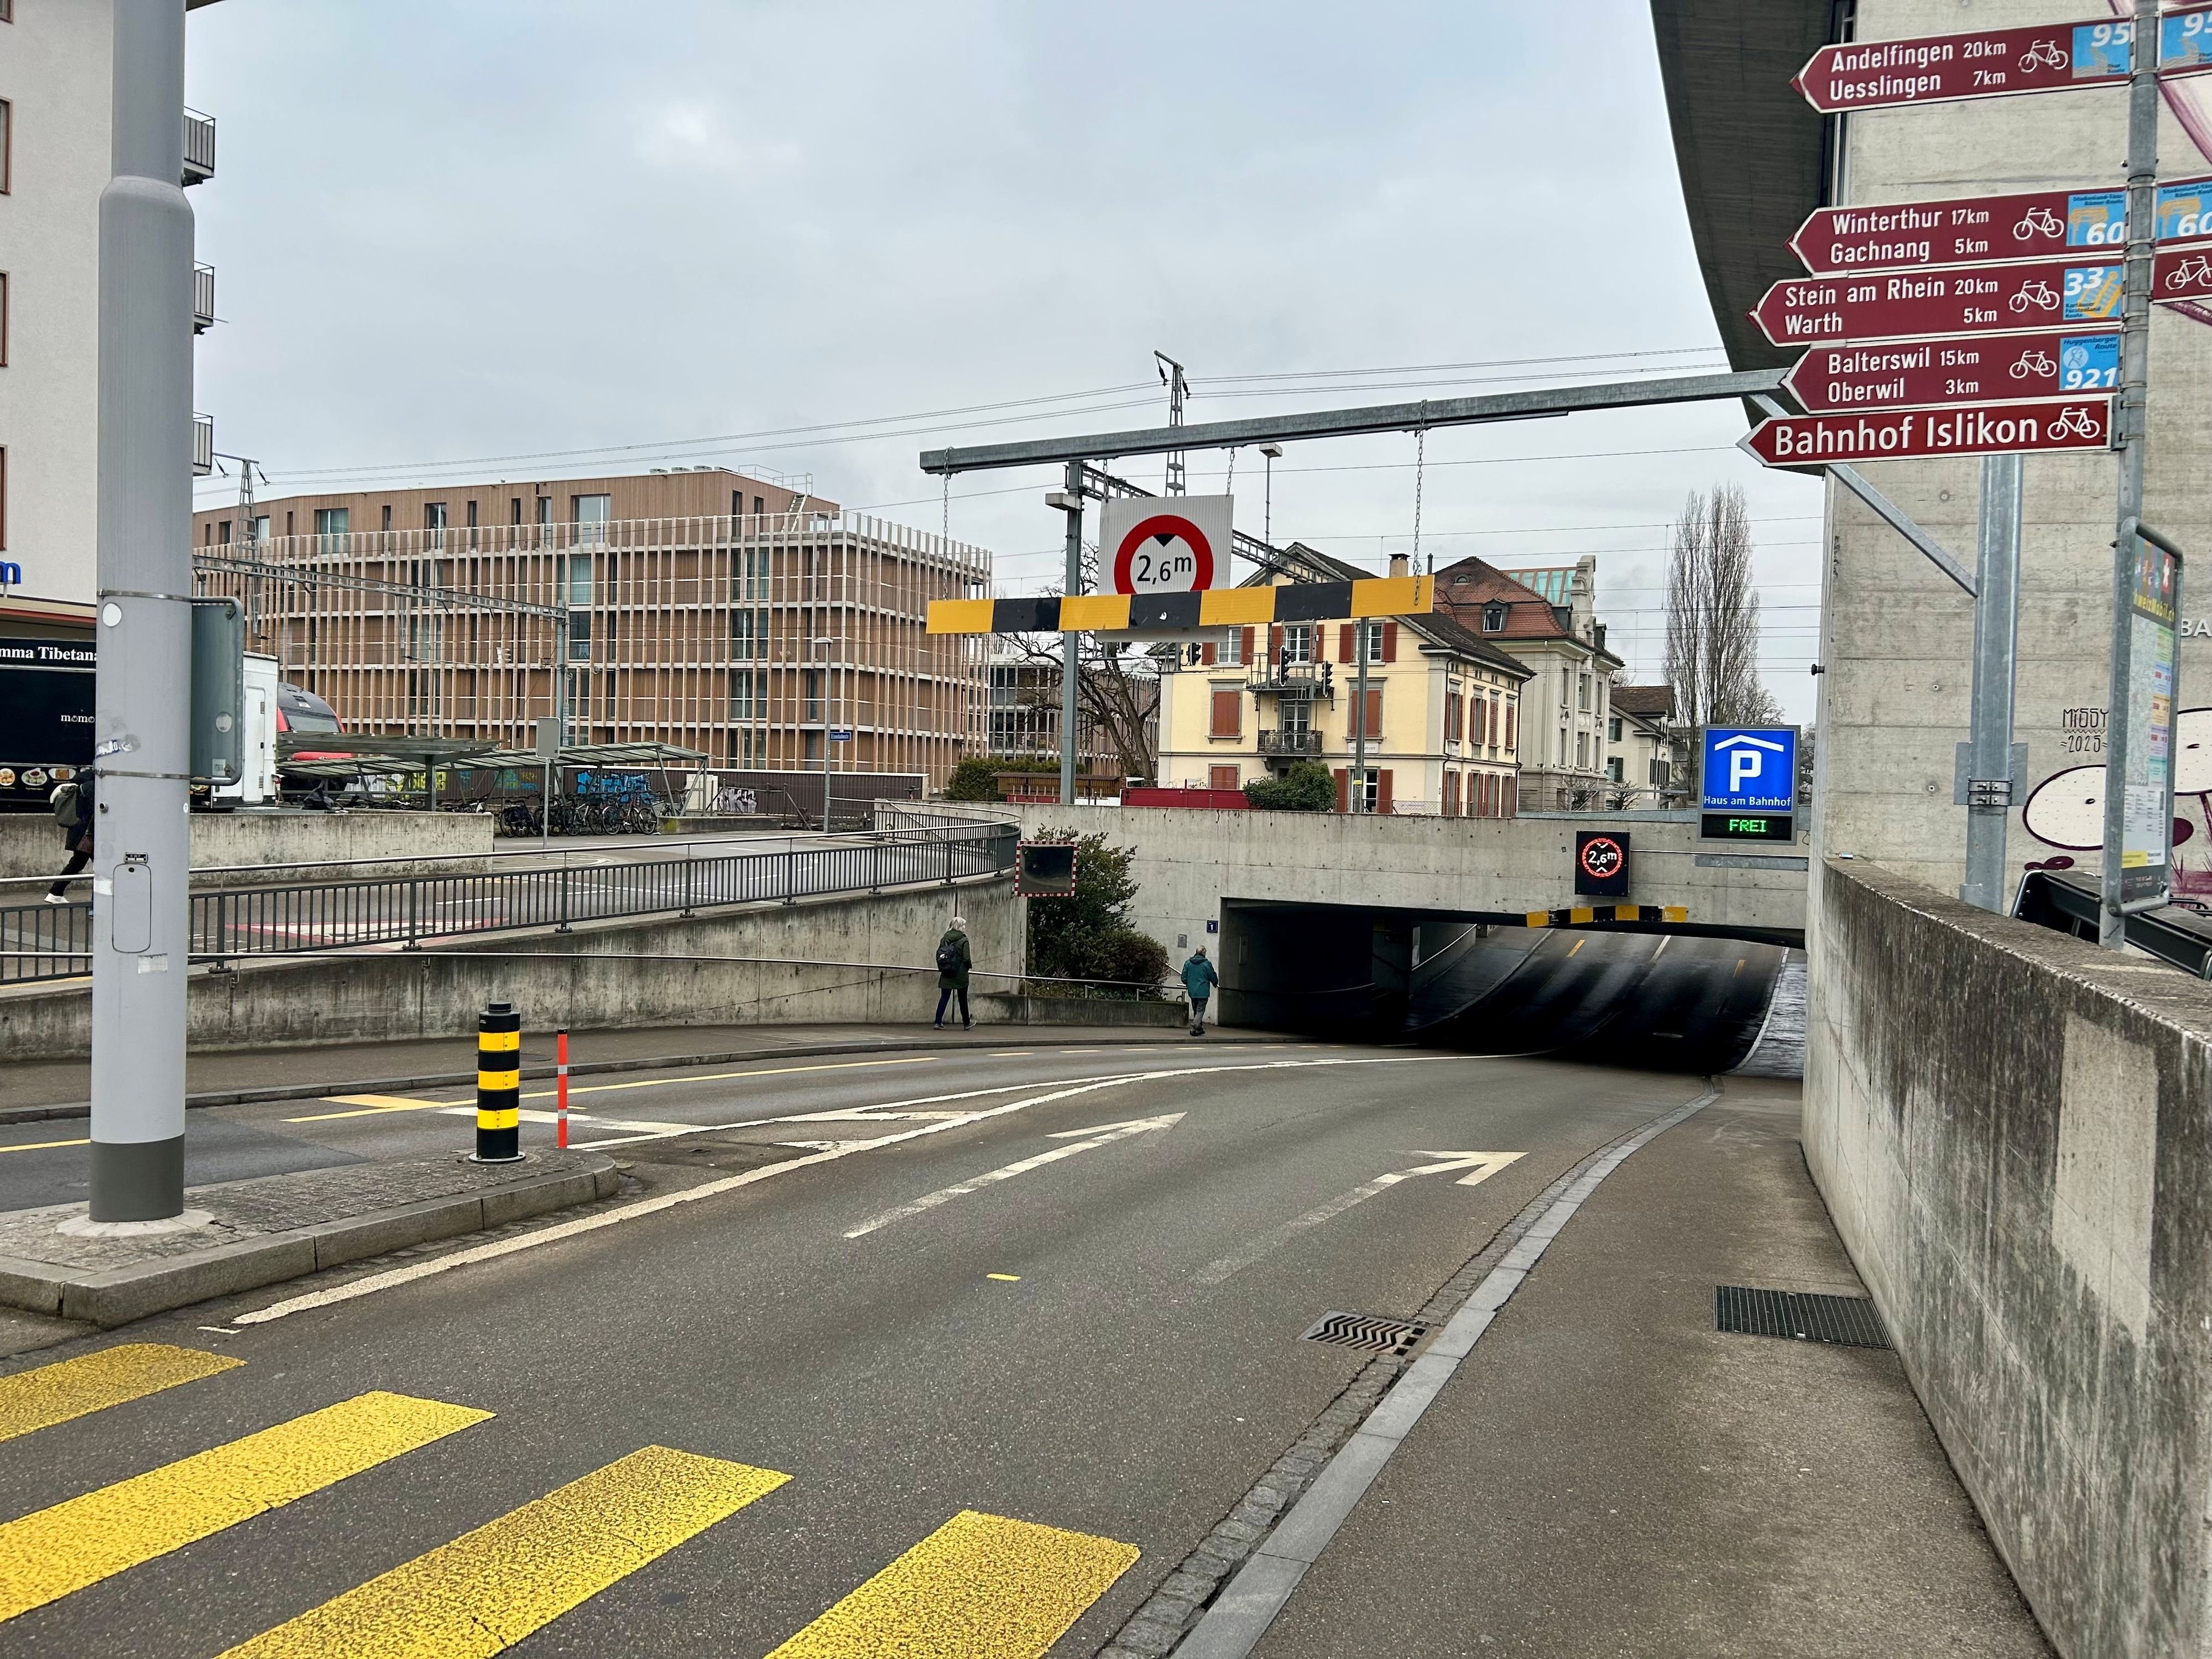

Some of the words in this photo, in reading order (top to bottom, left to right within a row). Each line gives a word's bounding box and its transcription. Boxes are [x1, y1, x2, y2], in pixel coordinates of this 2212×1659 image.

[2091, 21, 2129, 47] 95
[1831, 41, 1954, 72] Andelfingen
[1963, 41, 2007, 59] 20km
[1830, 72, 1941, 101] Uesslingen
[1973, 71, 2006, 87] 7km
[1832, 208, 1943, 235] Winterthur
[1952, 209, 1990, 226] 17km
[2086, 221, 2125, 246] 60
[2177, 211, 2212, 237] 60
[1830, 238, 1930, 264] Gachnang
[1954, 238, 1989, 254] 5km
[1785, 285, 1836, 307] Stein
[1847, 285, 1877, 302] am
[1887, 277, 1945, 300] Rhein
[1954, 278, 1999, 295] 20km
[2064, 267, 2104, 296] 33
[1785, 315, 1843, 335] Warth
[1963, 307, 1997, 323] 5km
[2064, 336, 2117, 346] Huggenberger
[1828, 347, 1930, 375] Balterswil
[1940, 350, 1980, 366] 15km
[1828, 377, 1905, 404] Oberwil
[1945, 379, 1979, 395] 3km
[2065, 367, 2117, 389] 921
[1775, 415, 1914, 456] Bahnhof
[1927, 413, 2038, 448] Islikon
[0, 649, 34, 659] mma
[38, 646, 96, 661] Tibetan
[2068, 735, 2101, 753] 2025
[1730, 750, 1762, 792] P
[1704, 796, 1728, 805] Haus
[1749, 796, 1791, 806] Bahnhof
[1729, 819, 1766, 832] FREI
